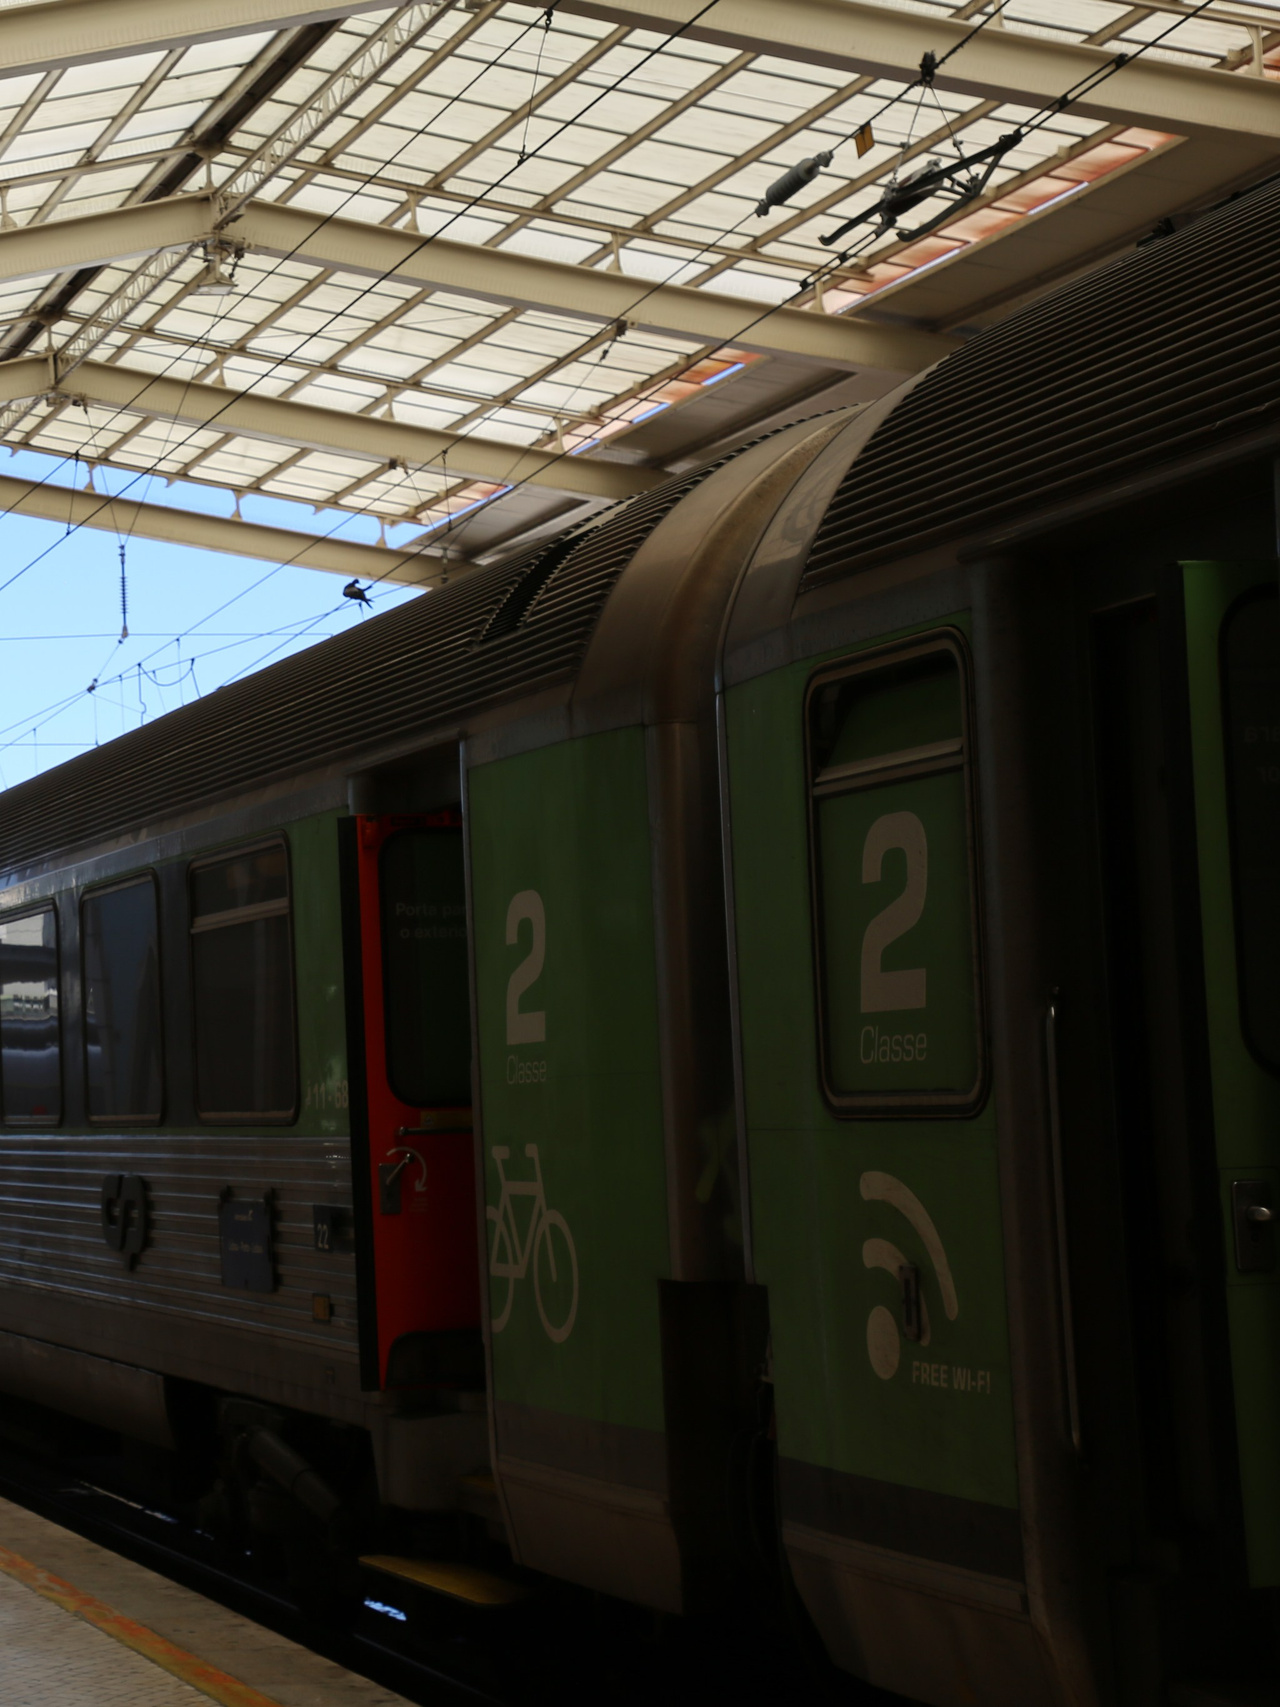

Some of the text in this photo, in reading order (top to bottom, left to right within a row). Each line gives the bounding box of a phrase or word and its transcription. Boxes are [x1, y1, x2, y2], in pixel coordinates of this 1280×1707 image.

[441, 904, 467, 919] par
[859, 810, 929, 1014] 2
[505, 889, 547, 1047] 2
[859, 1025, 929, 1065] Classe
[505, 1055, 548, 1085] Classe
[912, 1361, 991, 1395] FREE WI-FI
